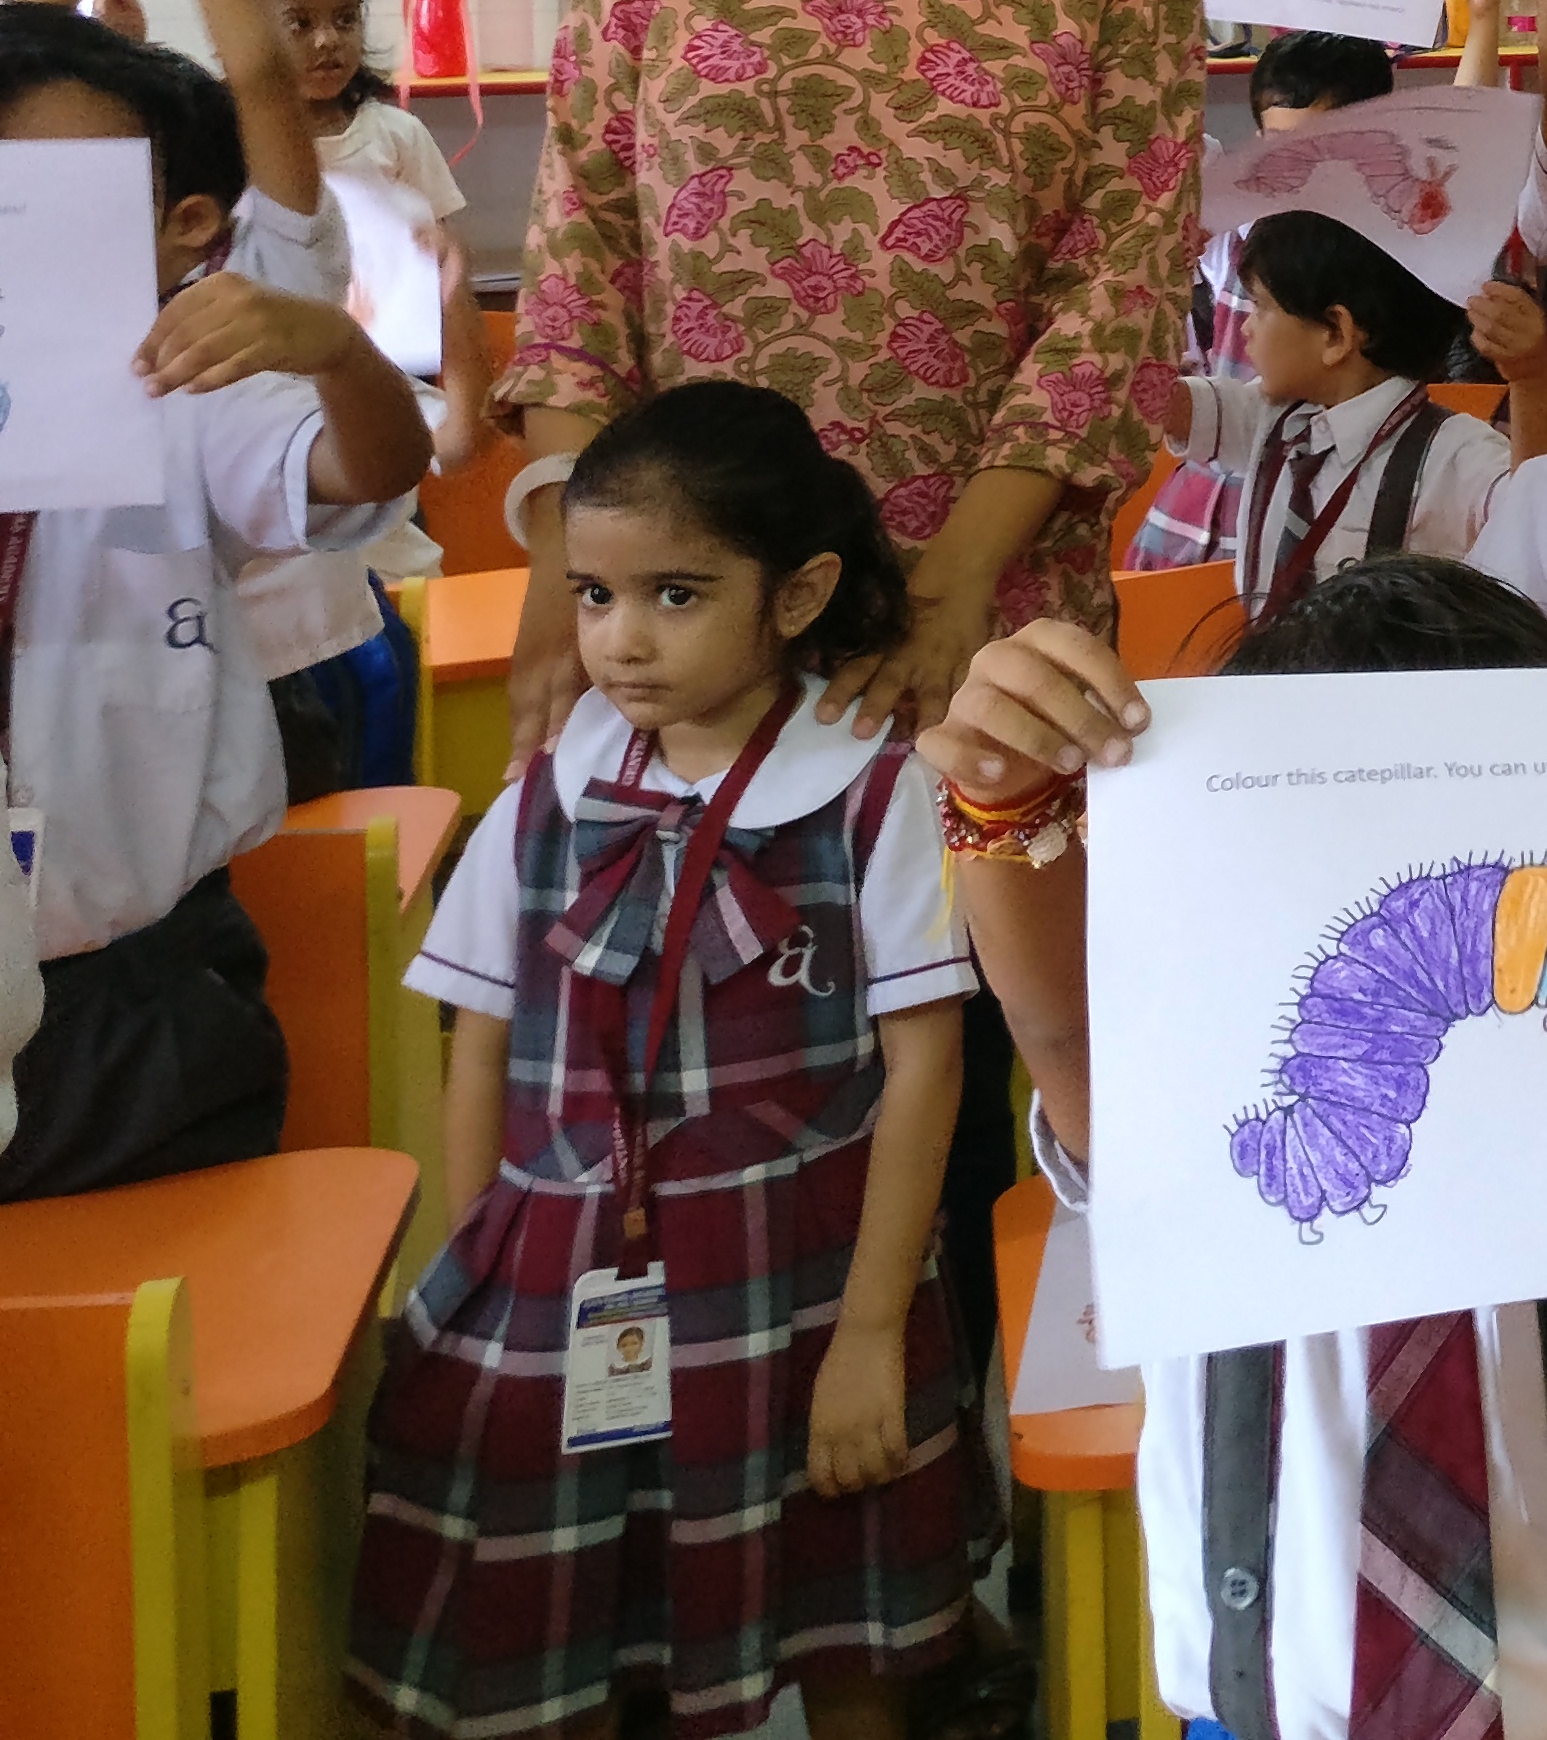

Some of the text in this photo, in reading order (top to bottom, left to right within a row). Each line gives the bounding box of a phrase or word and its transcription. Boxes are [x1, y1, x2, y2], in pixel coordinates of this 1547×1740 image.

[1206, 771, 1281, 793] Colour
[1286, 767, 1328, 786] this
[1333, 762, 1438, 785] catepillar.
[1444, 760, 1482, 778] You
[1489, 761, 1526, 777] can
